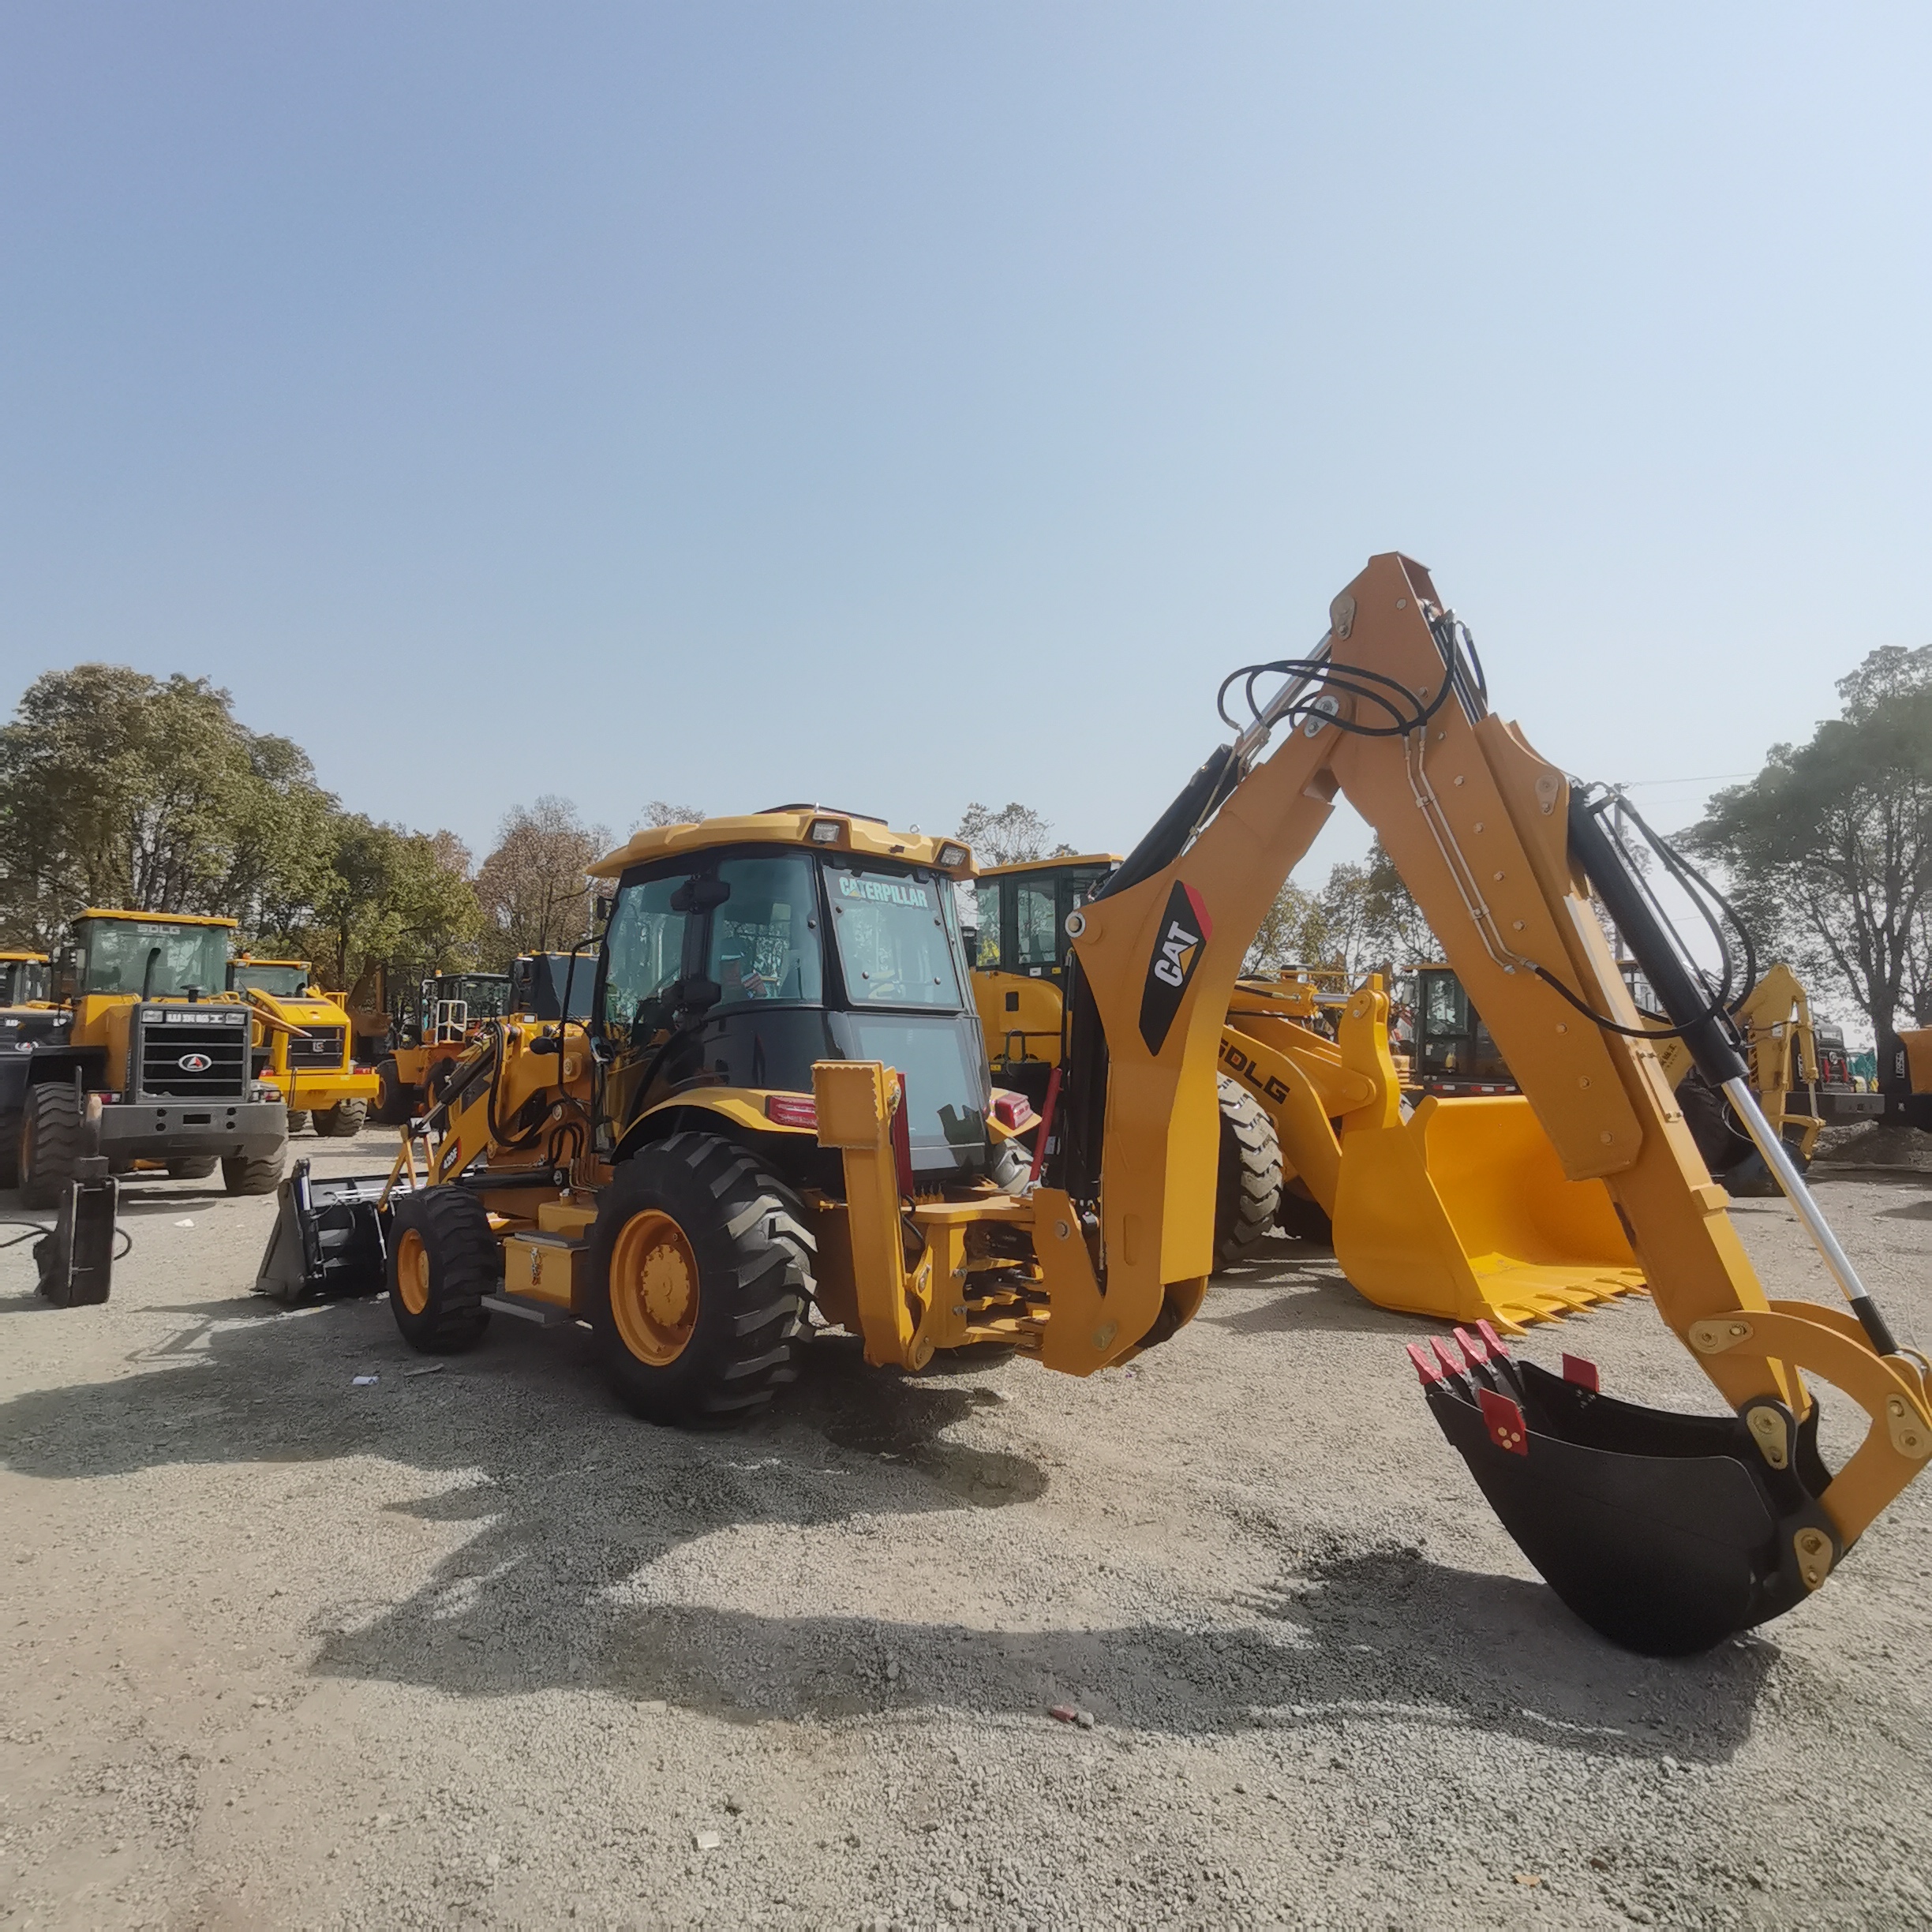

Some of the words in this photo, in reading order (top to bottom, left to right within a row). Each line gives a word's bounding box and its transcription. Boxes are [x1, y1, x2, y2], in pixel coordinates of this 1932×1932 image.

[839, 877, 928, 908] CATERPILLAR
[137, 923, 181, 935] SDLG
[1155, 920, 1199, 987] CAT
